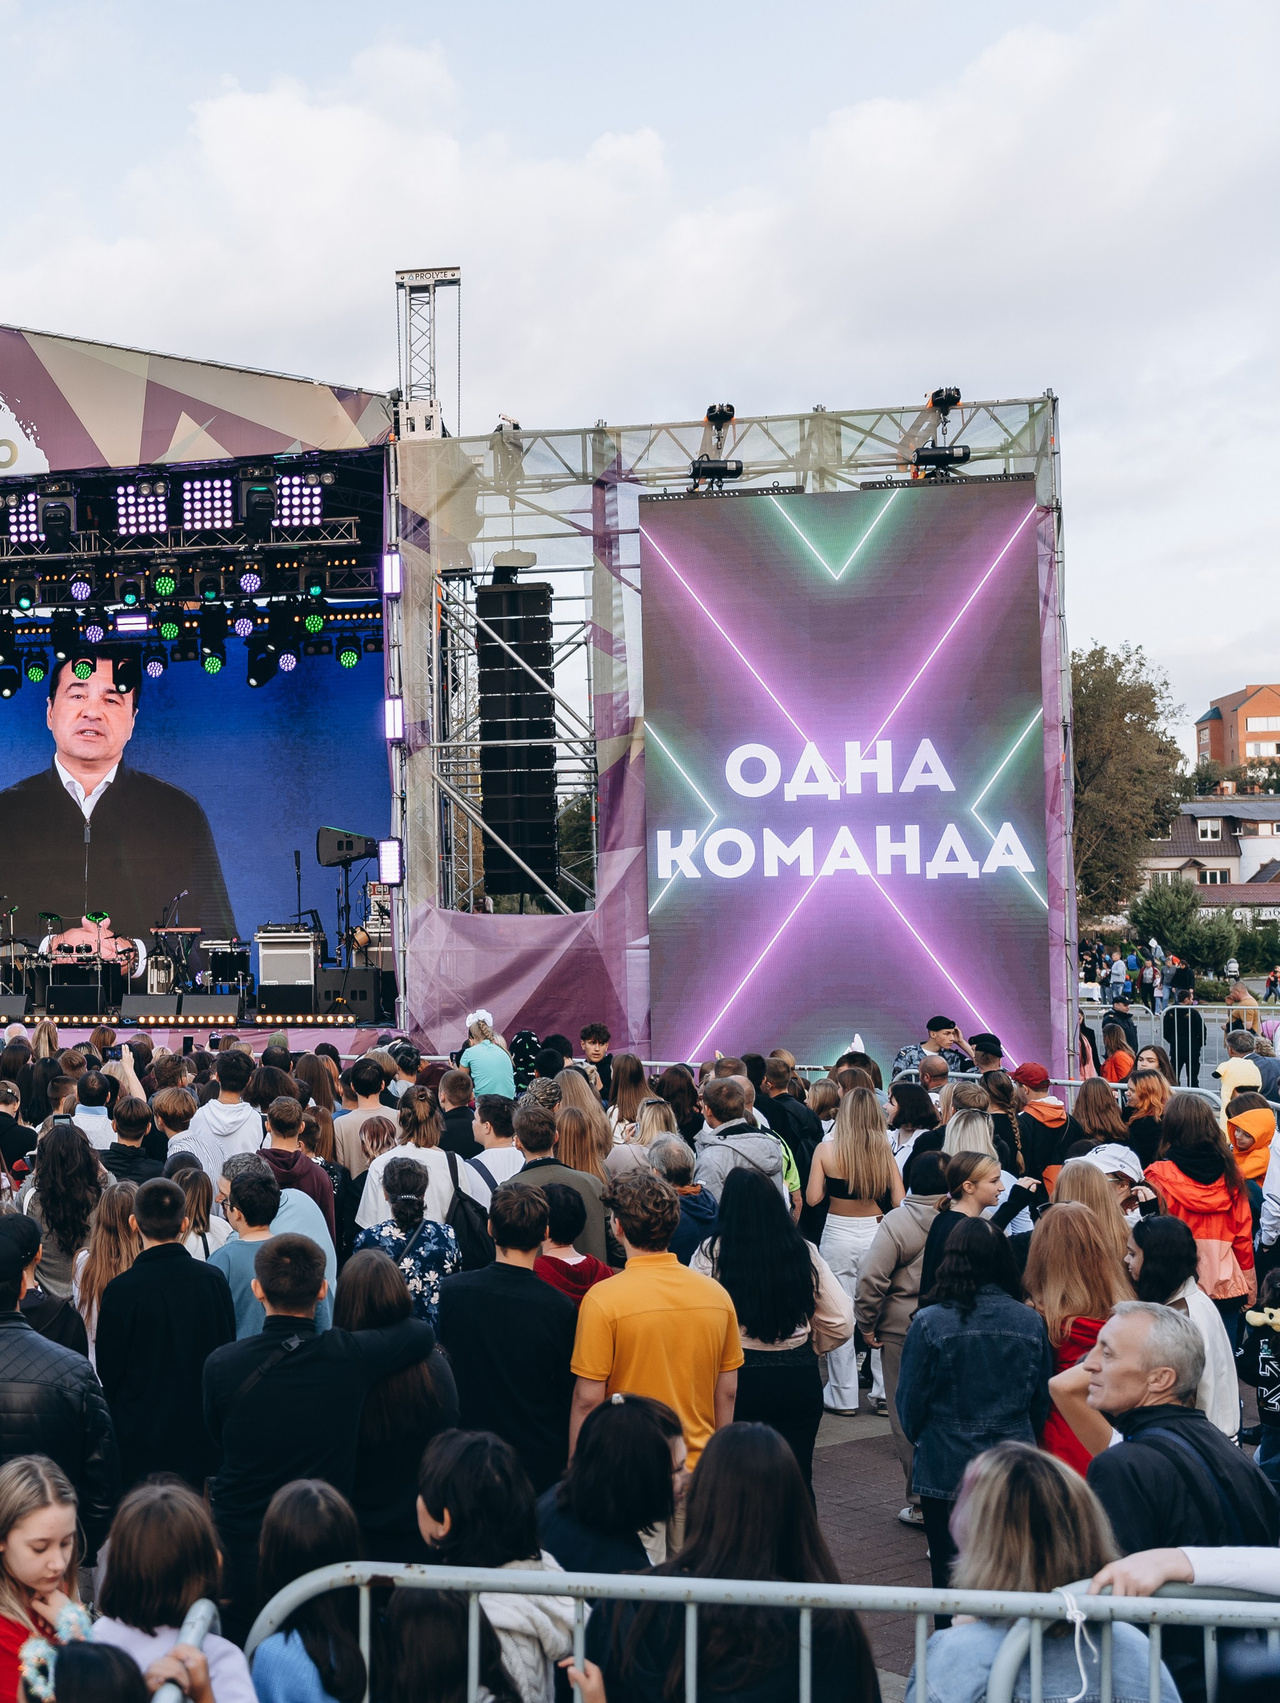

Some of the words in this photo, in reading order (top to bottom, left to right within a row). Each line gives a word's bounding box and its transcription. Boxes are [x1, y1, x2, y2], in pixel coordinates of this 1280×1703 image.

[415, 271, 448, 281] PROLYTE
[725, 738, 956, 802] ОДНА
[656, 821, 1036, 880] КОМАНДА
